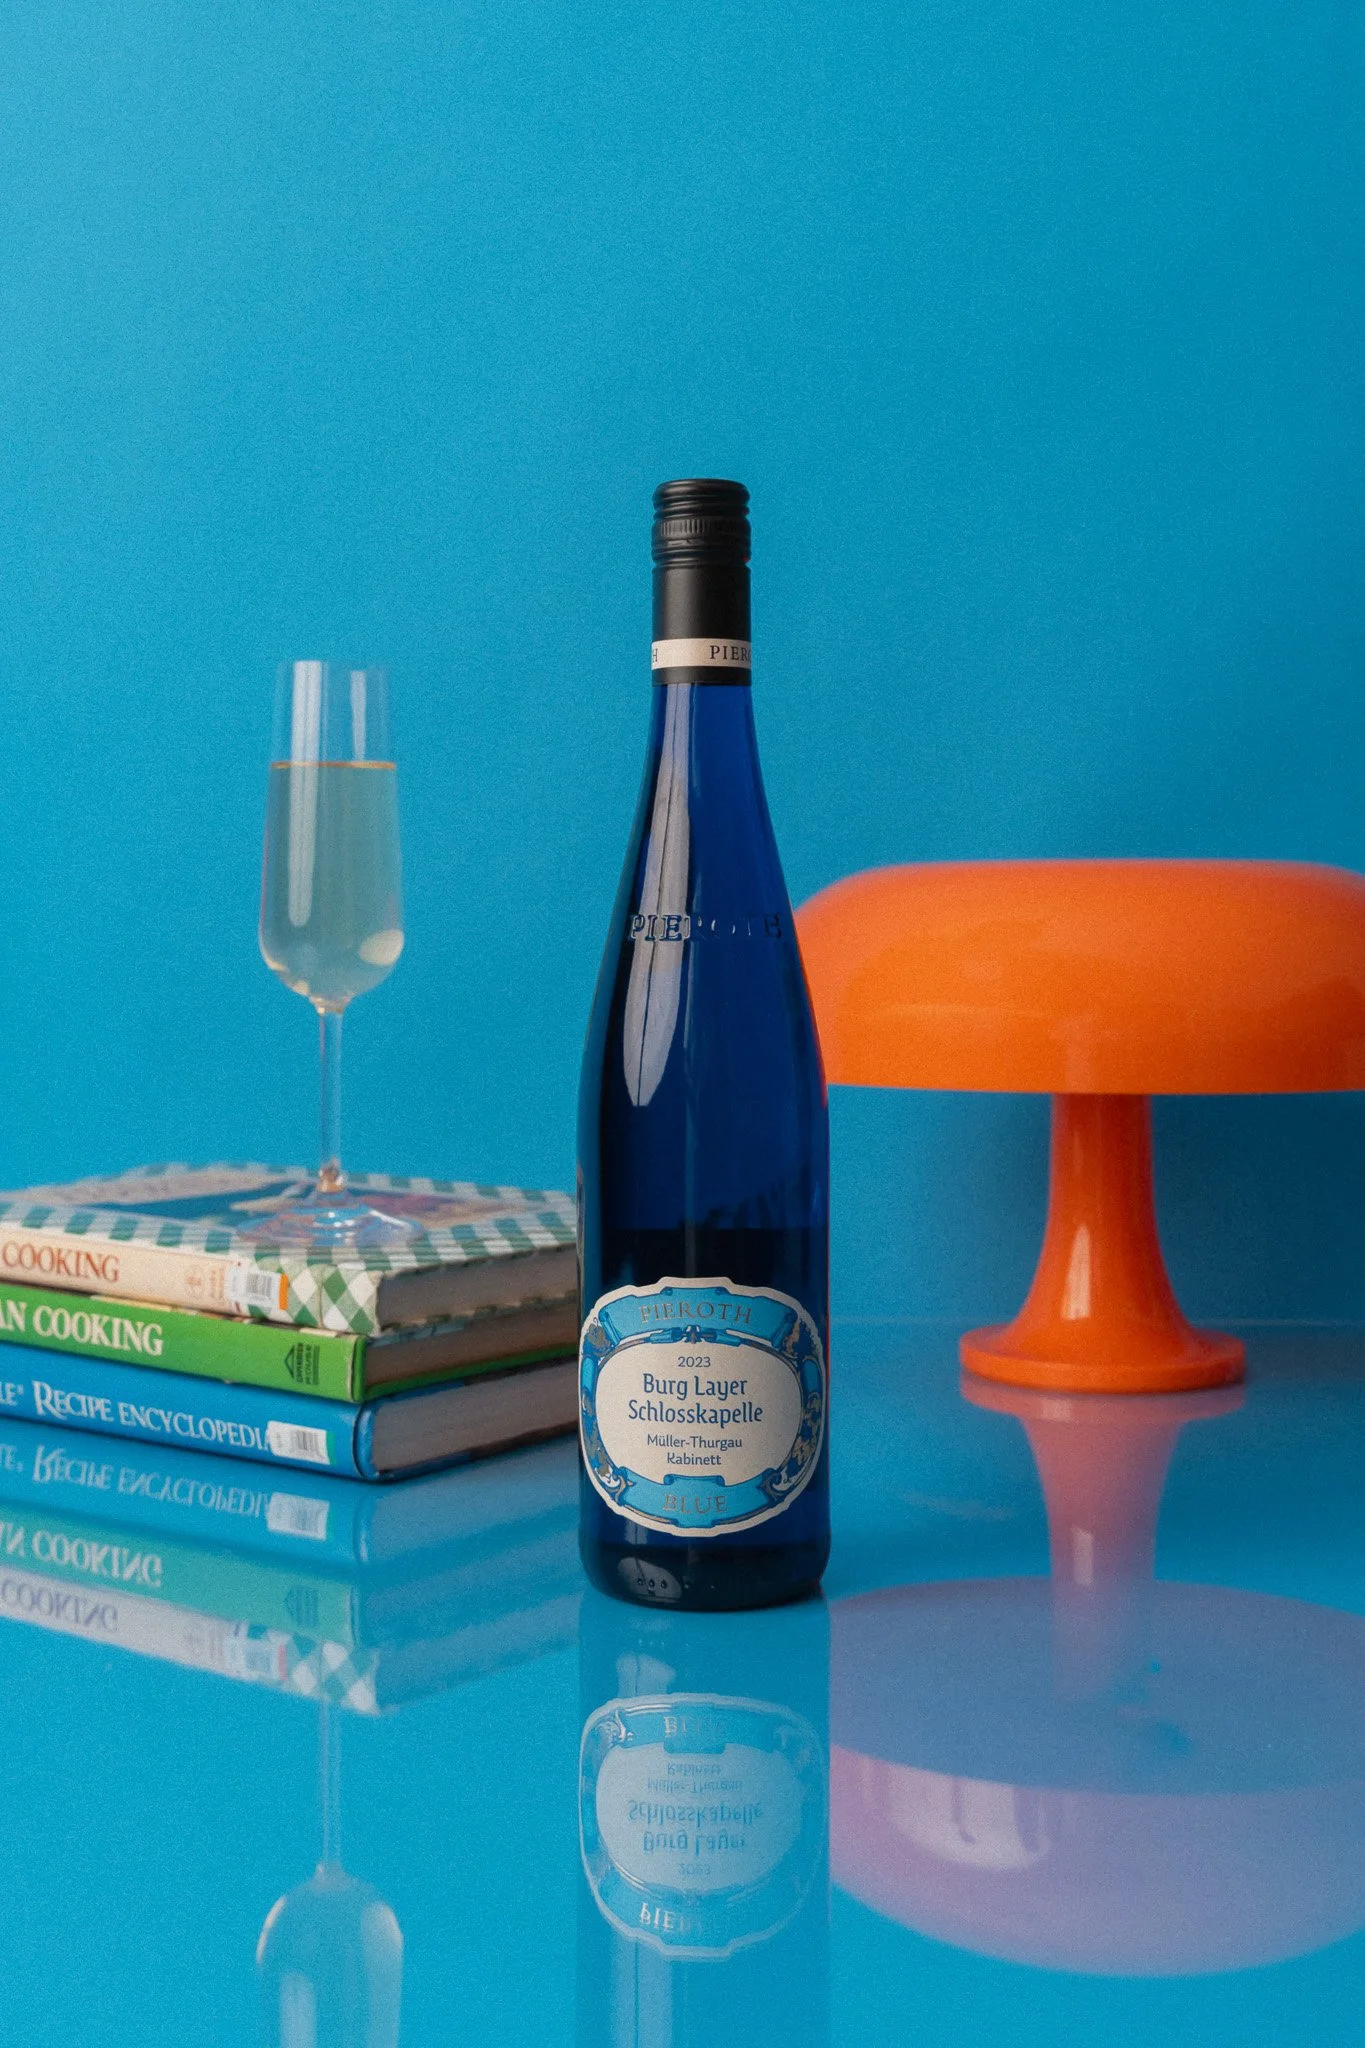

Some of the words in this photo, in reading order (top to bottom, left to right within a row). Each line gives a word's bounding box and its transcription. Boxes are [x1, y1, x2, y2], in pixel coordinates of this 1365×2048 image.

[629, 914, 782, 942] PIEH
[2, 1240, 120, 1283] COOKING
[638, 1302, 751, 1324] PIEROTH
[33, 1305, 164, 1356] COOKING
[677, 1356, 711, 1368] 2023
[643, 1373, 688, 1400] Burg
[694, 1375, 747, 1400] Layer
[628, 1400, 763, 1428] Schlosskapelle
[647, 1434, 742, 1450] Müller-Thurgau
[667, 1454, 721, 1465] Kabinett
[663, 1495, 728, 1514] BLUE
